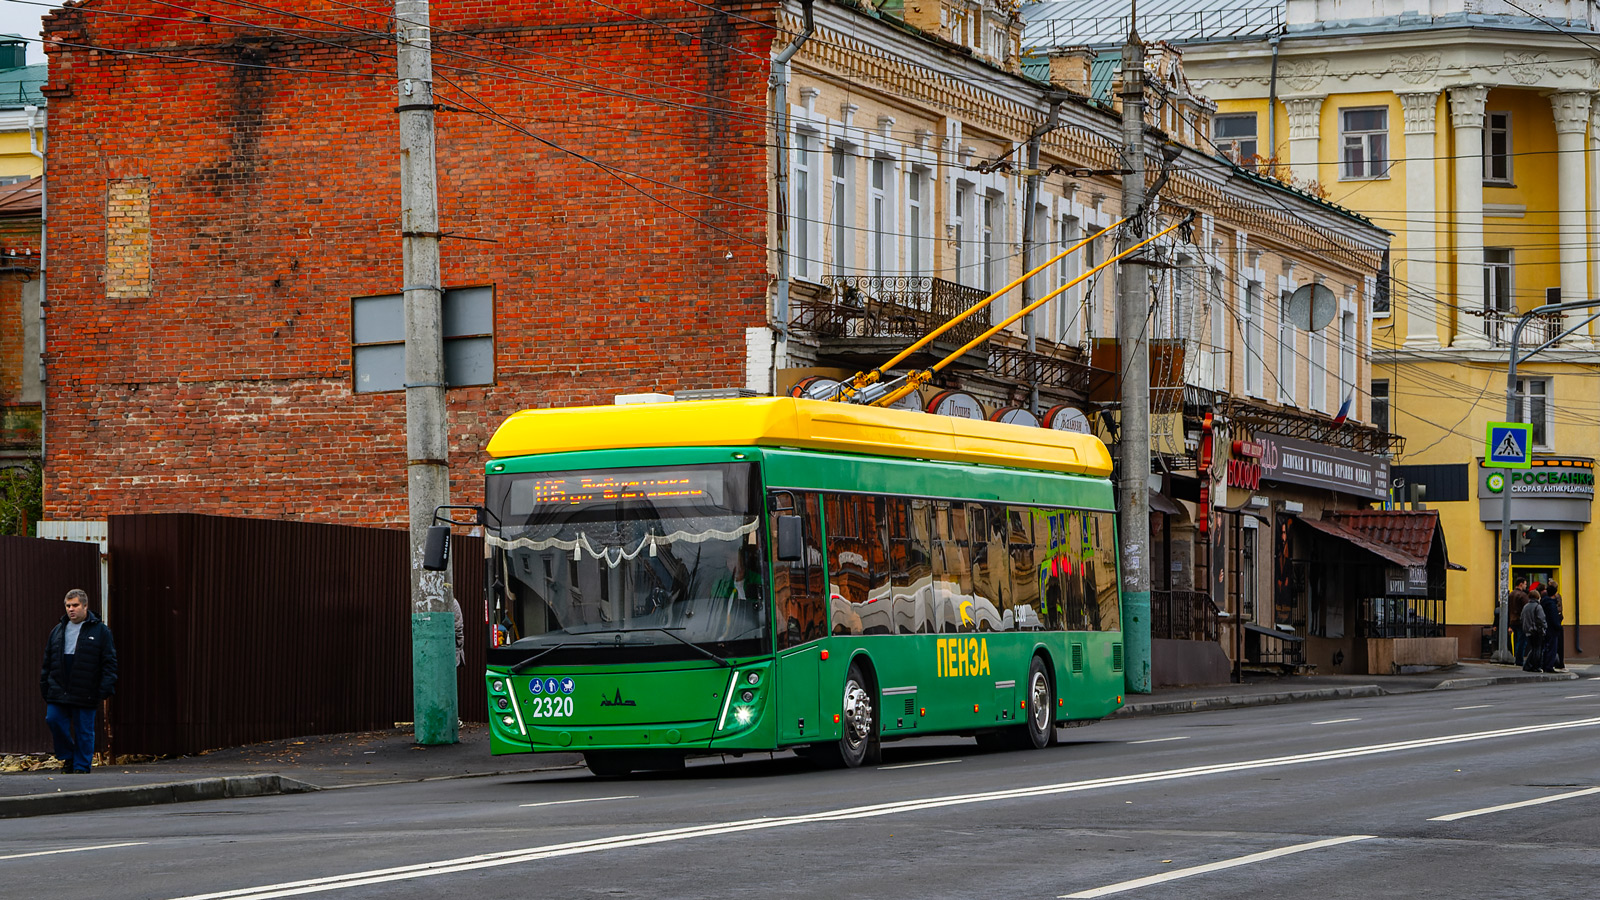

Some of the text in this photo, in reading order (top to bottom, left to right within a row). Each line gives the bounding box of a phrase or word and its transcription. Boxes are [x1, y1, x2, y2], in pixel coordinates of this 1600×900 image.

[1227, 459, 1261, 490] БОСФОР
[1282, 453, 1304, 472] ЖЕНСКАЯ
[1306, 457, 1310, 473] И
[1311, 458, 1333, 477] МУЖСКАЯ
[1355, 468, 1372, 486] ОДЕЖДА
[1511, 485, 1541, 493] СКОРАЯ
[936, 637, 991, 677] ПЕНЗА
[533, 696, 574, 718] 2320
